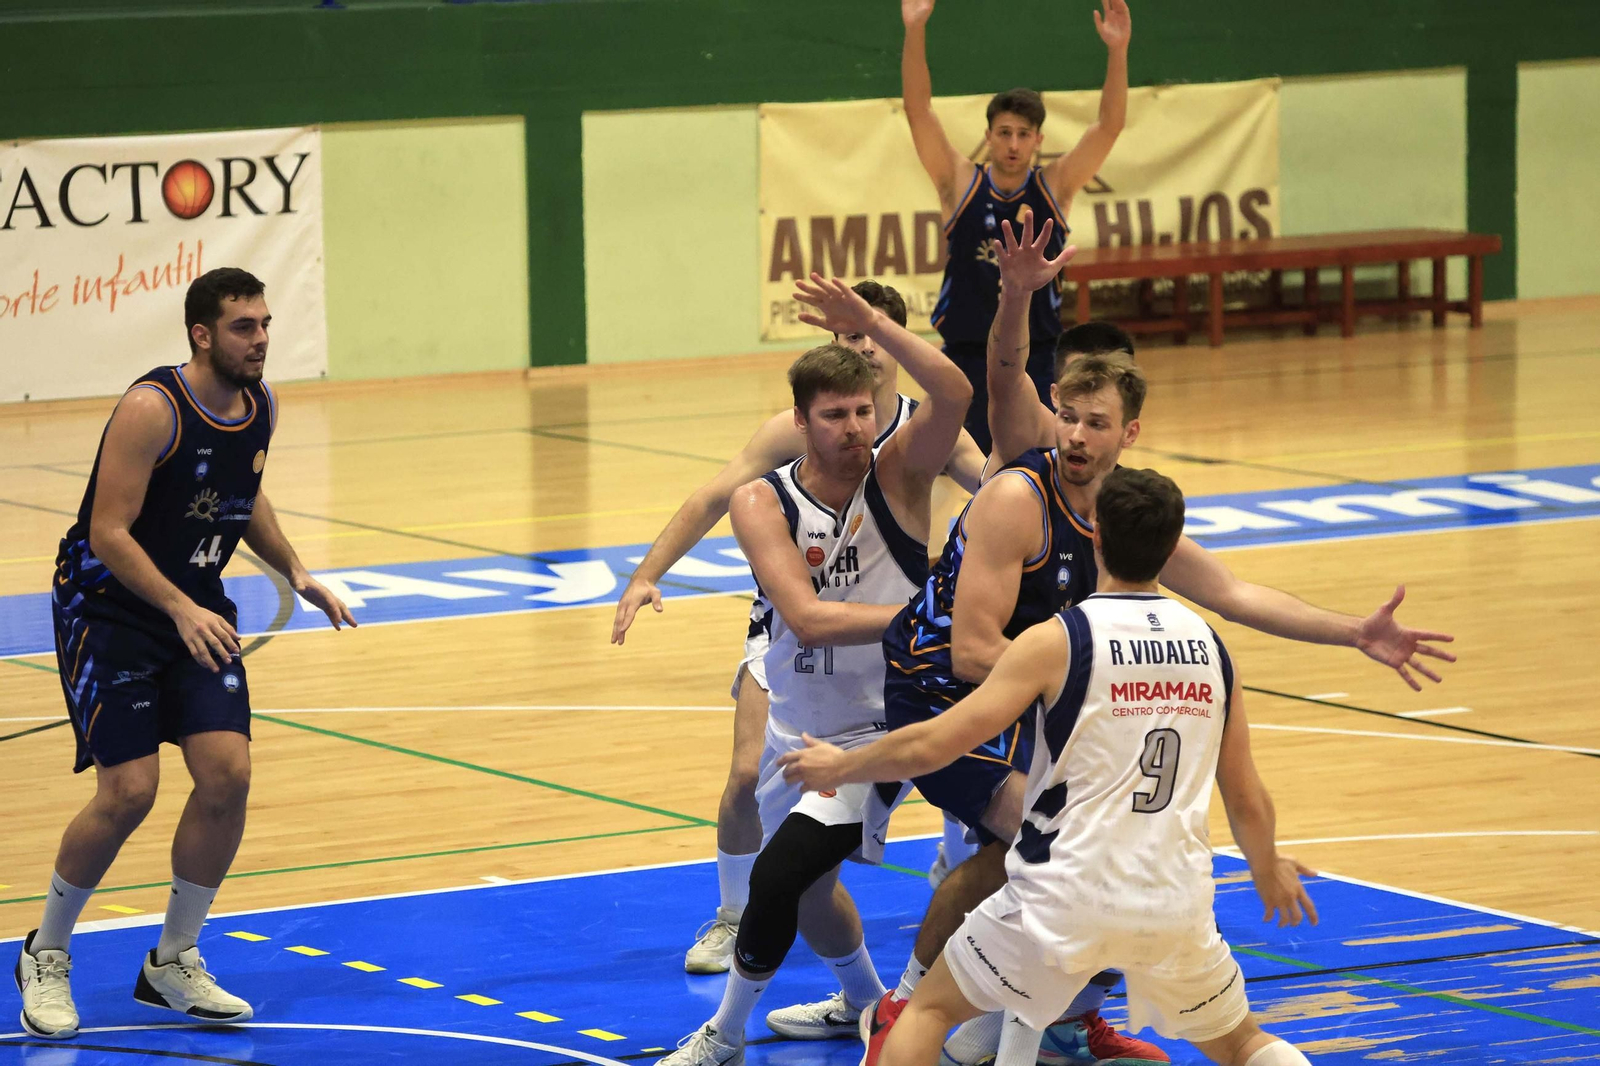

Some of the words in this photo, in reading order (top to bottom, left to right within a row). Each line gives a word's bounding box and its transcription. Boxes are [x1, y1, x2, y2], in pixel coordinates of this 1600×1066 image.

[0, 152, 310, 230] ACTORY
[73, 239, 203, 313] infantil
[189, 535, 222, 567] 44
[1110, 681, 1214, 704] MIRAMAR
[1112, 706, 1154, 717] CENTRO
[1155, 705, 1212, 719] COMERCIAL
[1131, 727, 1182, 814] 9
